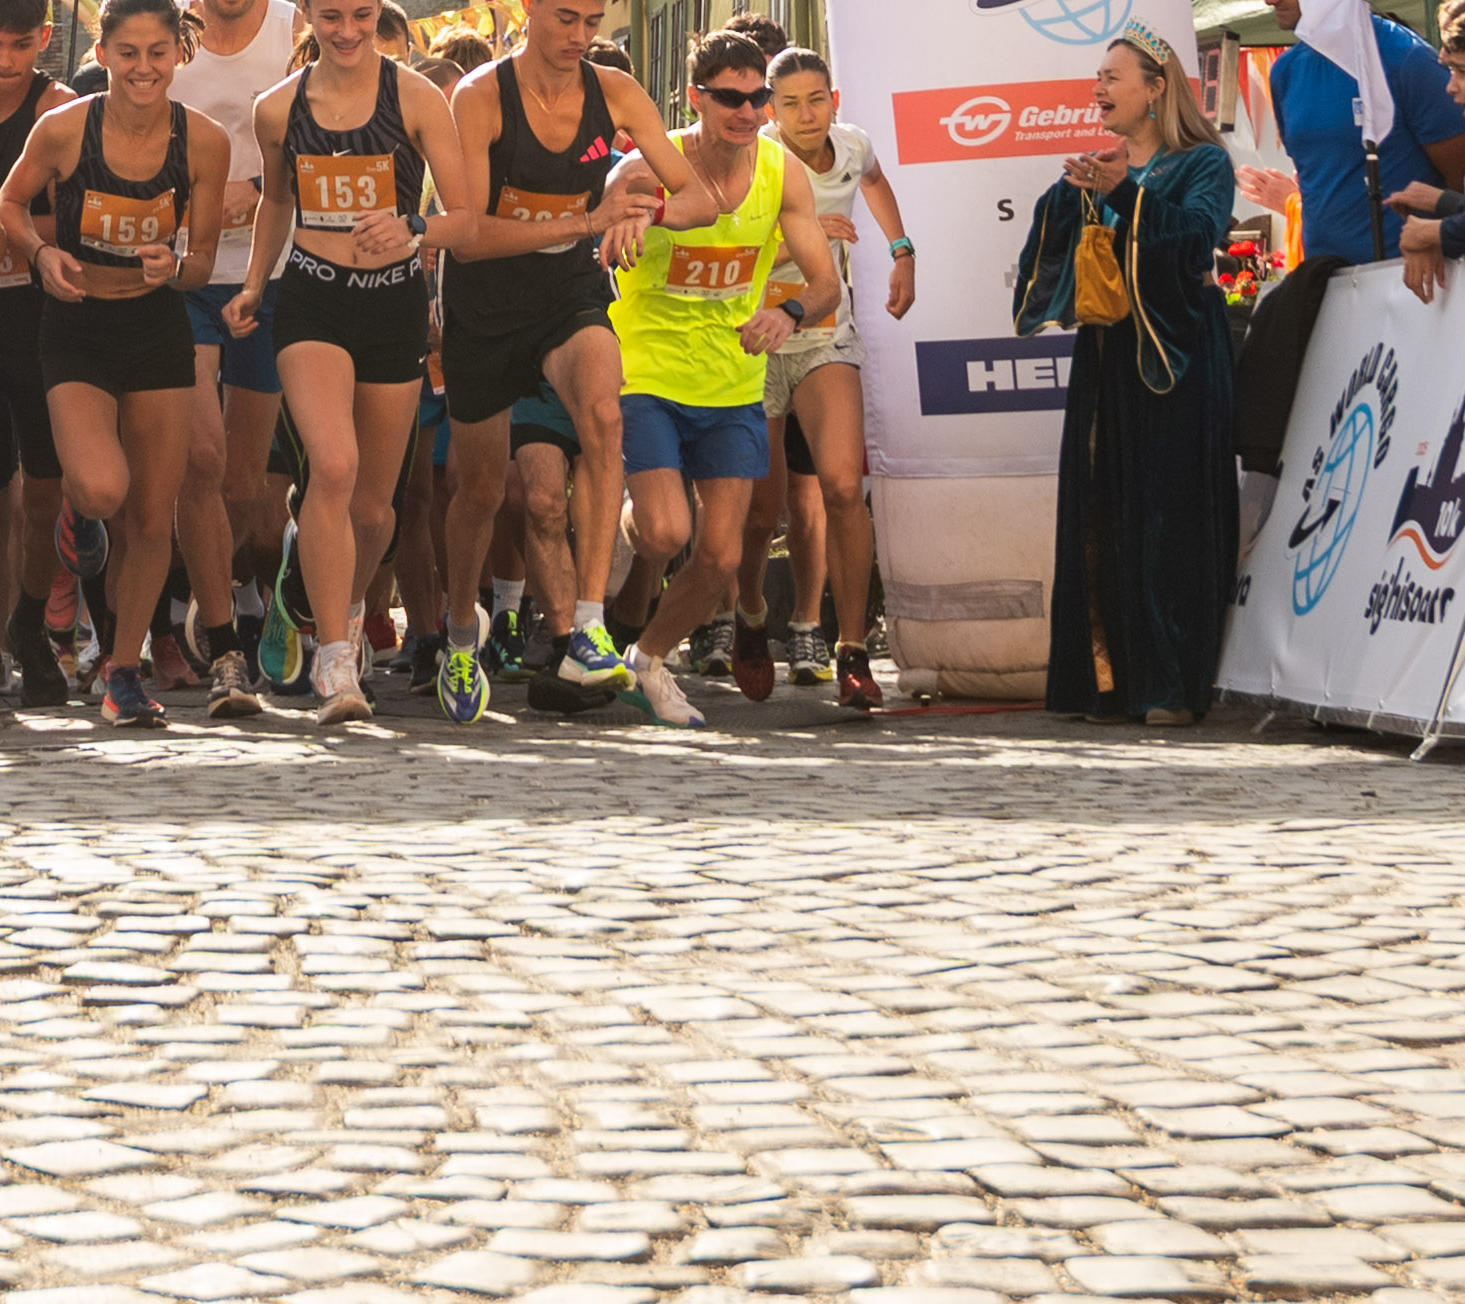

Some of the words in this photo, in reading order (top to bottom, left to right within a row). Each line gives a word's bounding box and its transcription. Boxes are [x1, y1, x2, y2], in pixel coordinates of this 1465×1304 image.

[1018, 103, 1101, 128] Gebrü
[1015, 128, 1071, 142] Transport
[1073, 127, 1095, 138] and
[315, 175, 378, 209] 153
[100, 214, 159, 243] 159
[290, 249, 336, 281] PRO
[347, 265, 406, 289] NIKE
[685, 259, 741, 286] 210
